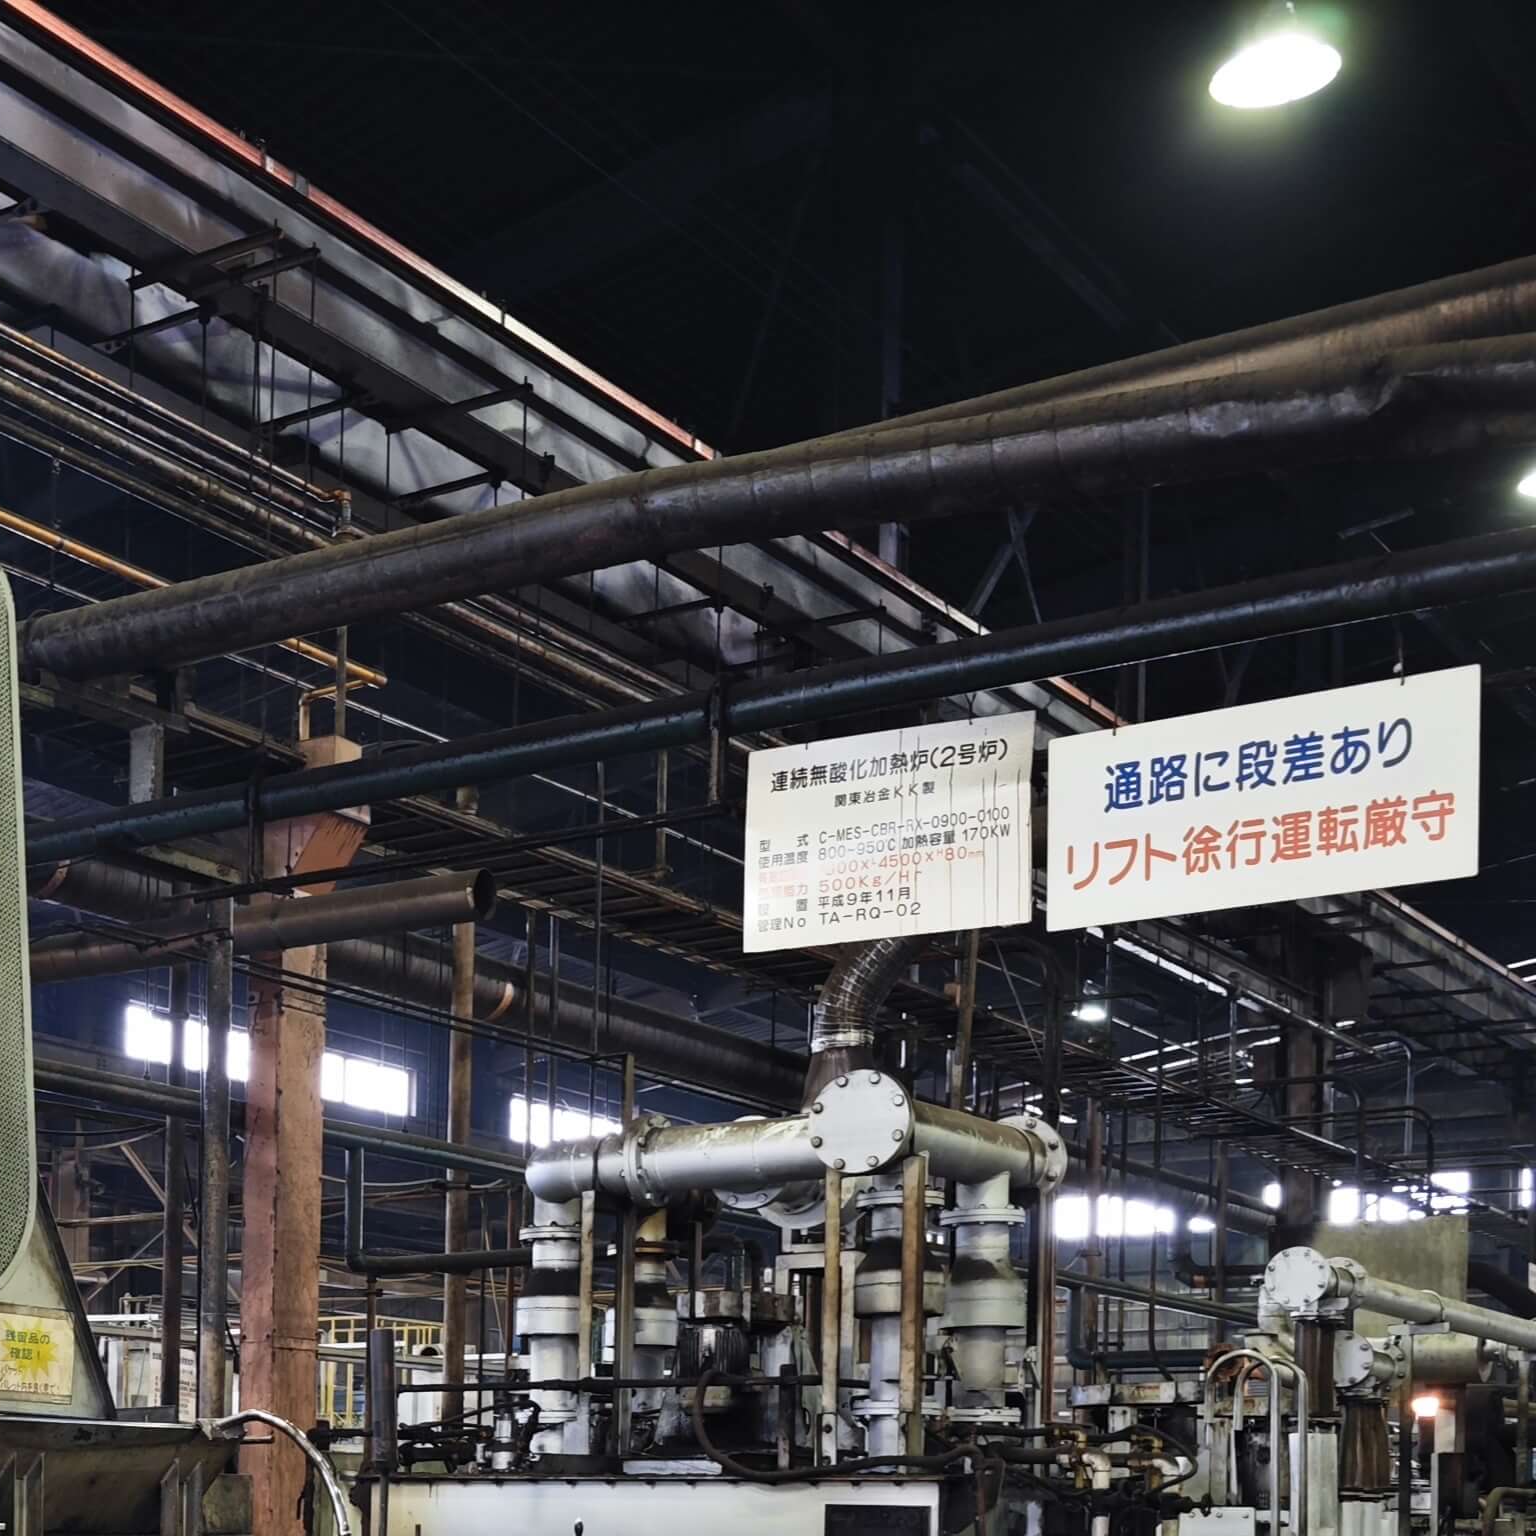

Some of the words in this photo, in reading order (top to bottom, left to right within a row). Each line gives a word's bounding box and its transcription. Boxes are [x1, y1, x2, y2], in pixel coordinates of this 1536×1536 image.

[1104, 717, 1413, 814] 通路に段差あり
[962, 823, 1011, 842] 170KW
[1066, 789, 1456, 891] リフト徐行運転厳守
[817, 886, 911, 909] 平成9年11月
[818, 901, 922, 926] TA-RQ-02
